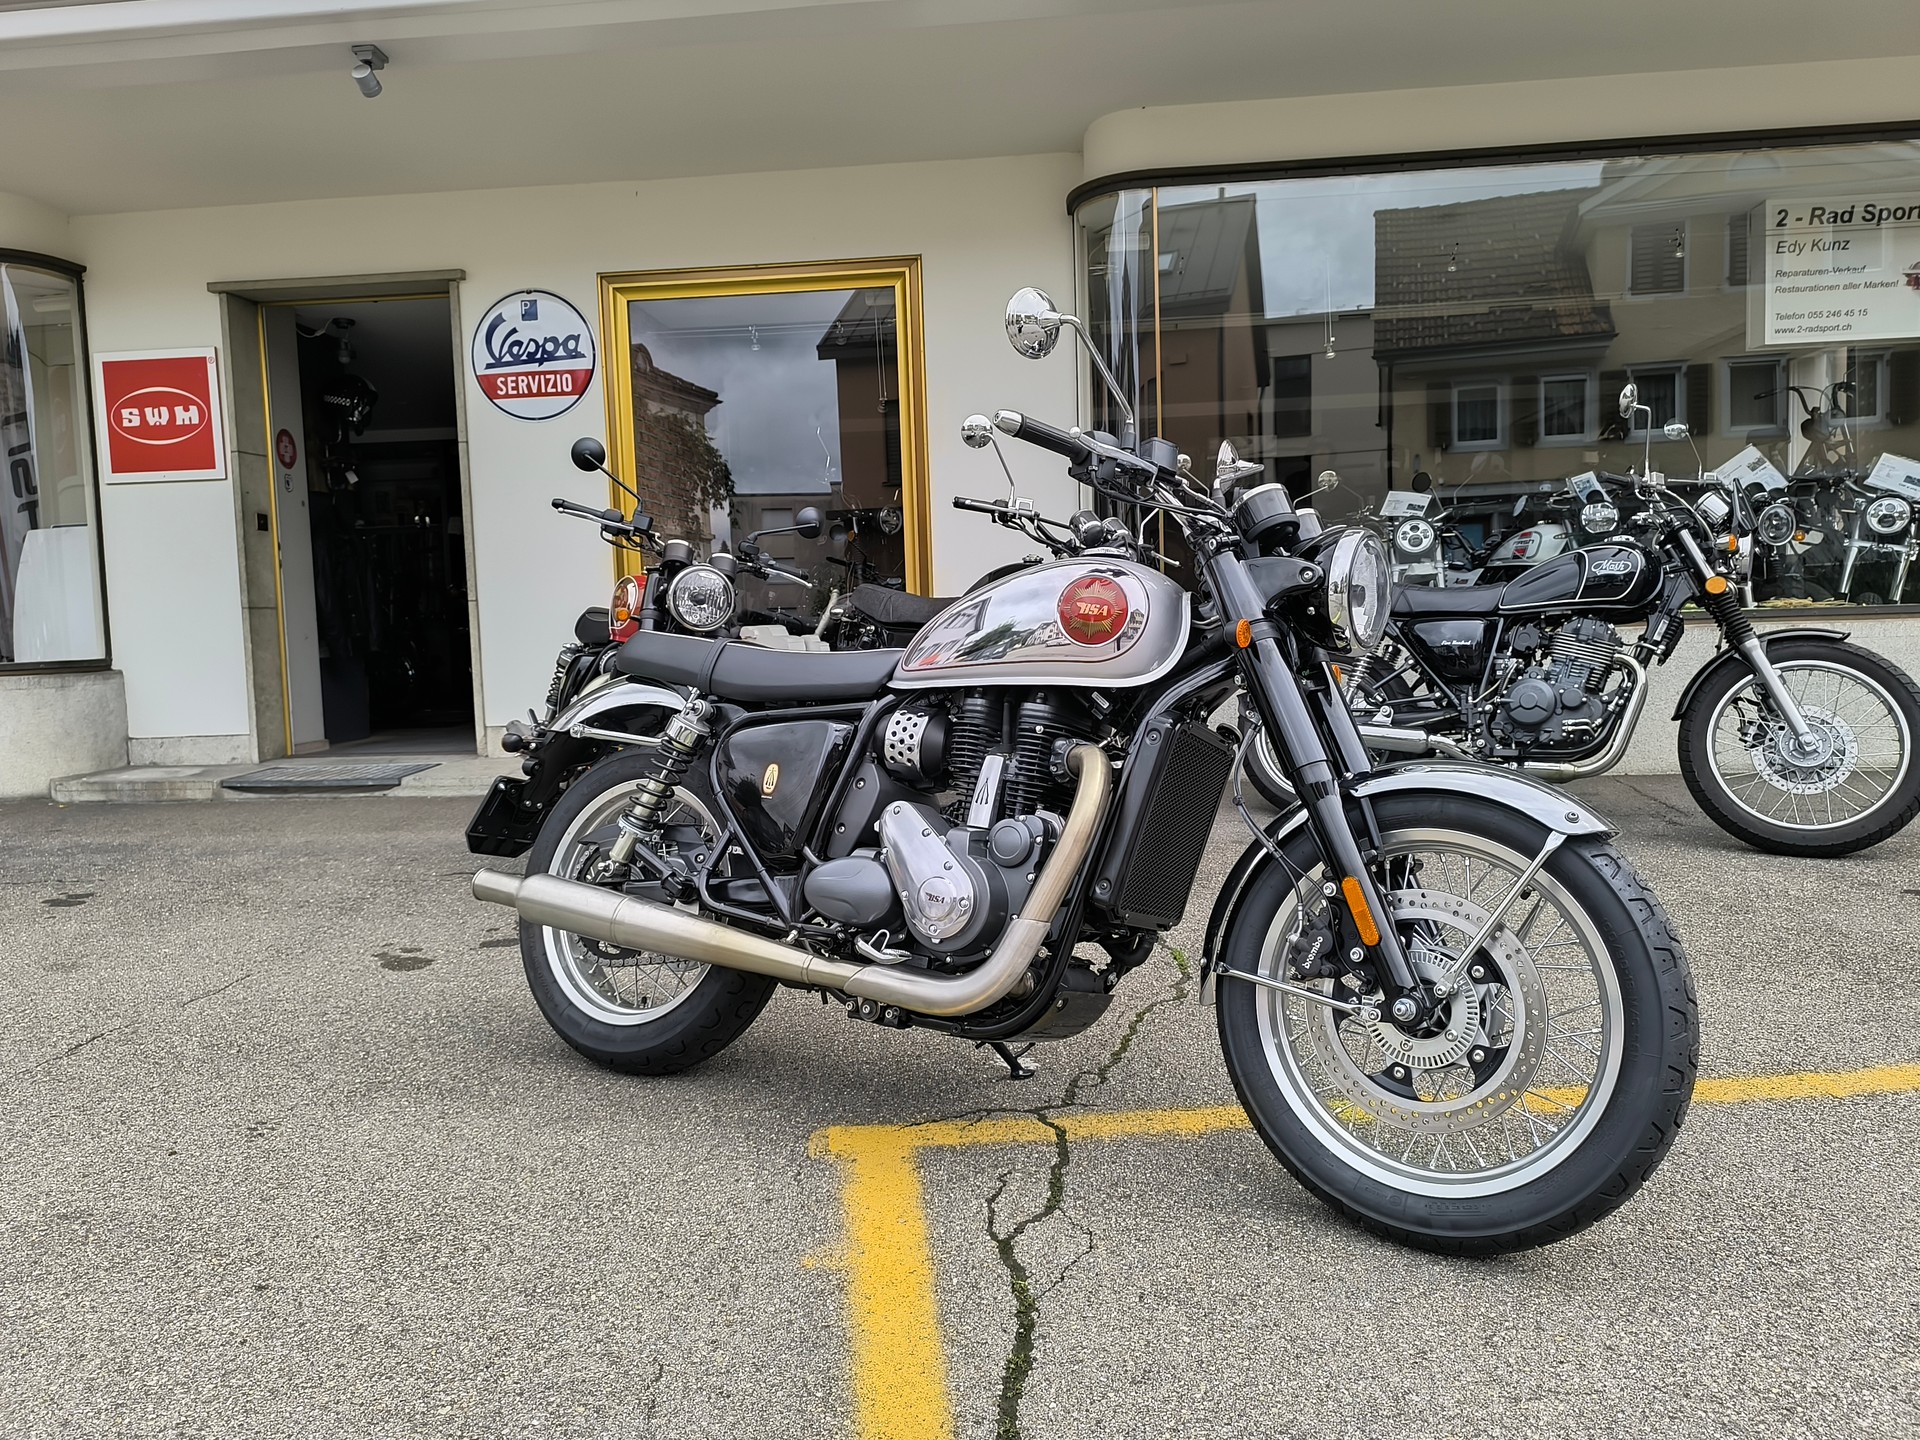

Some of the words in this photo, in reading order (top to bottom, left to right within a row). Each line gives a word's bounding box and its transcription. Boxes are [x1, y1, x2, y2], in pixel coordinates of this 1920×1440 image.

[1775, 208, 1789, 228] 2
[1808, 204, 1856, 226] Rad
[1861, 203, 1920, 227] Sport
[1775, 239, 1807, 257] Edy
[1810, 238, 1851, 252] Kunz
[1775, 265, 1866, 279] Reparaturen-Verkauf
[1774, 283, 1841, 294] Restaurationen
[1842, 281, 1862, 291] aller
[1863, 279, 1900, 290] Marken!
[521, 301, 531, 315] P
[1775, 310, 1806, 321] Telefon
[1807, 310, 1824, 320] 055
[1826, 309, 1842, 319] 246
[1844, 308, 1855, 318] 45
[1857, 307, 1869, 317] 15
[1774, 323, 1852, 334] www.2-radsport.ch
[484, 312, 587, 369] Vespa
[496, 373, 573, 396] SERVIZIO
[120, 405, 200, 428] SWM
[1076, 602, 1108, 616] BSA
[925, 892, 945, 904] BSA
[1302, 936, 1323, 969] brembo
